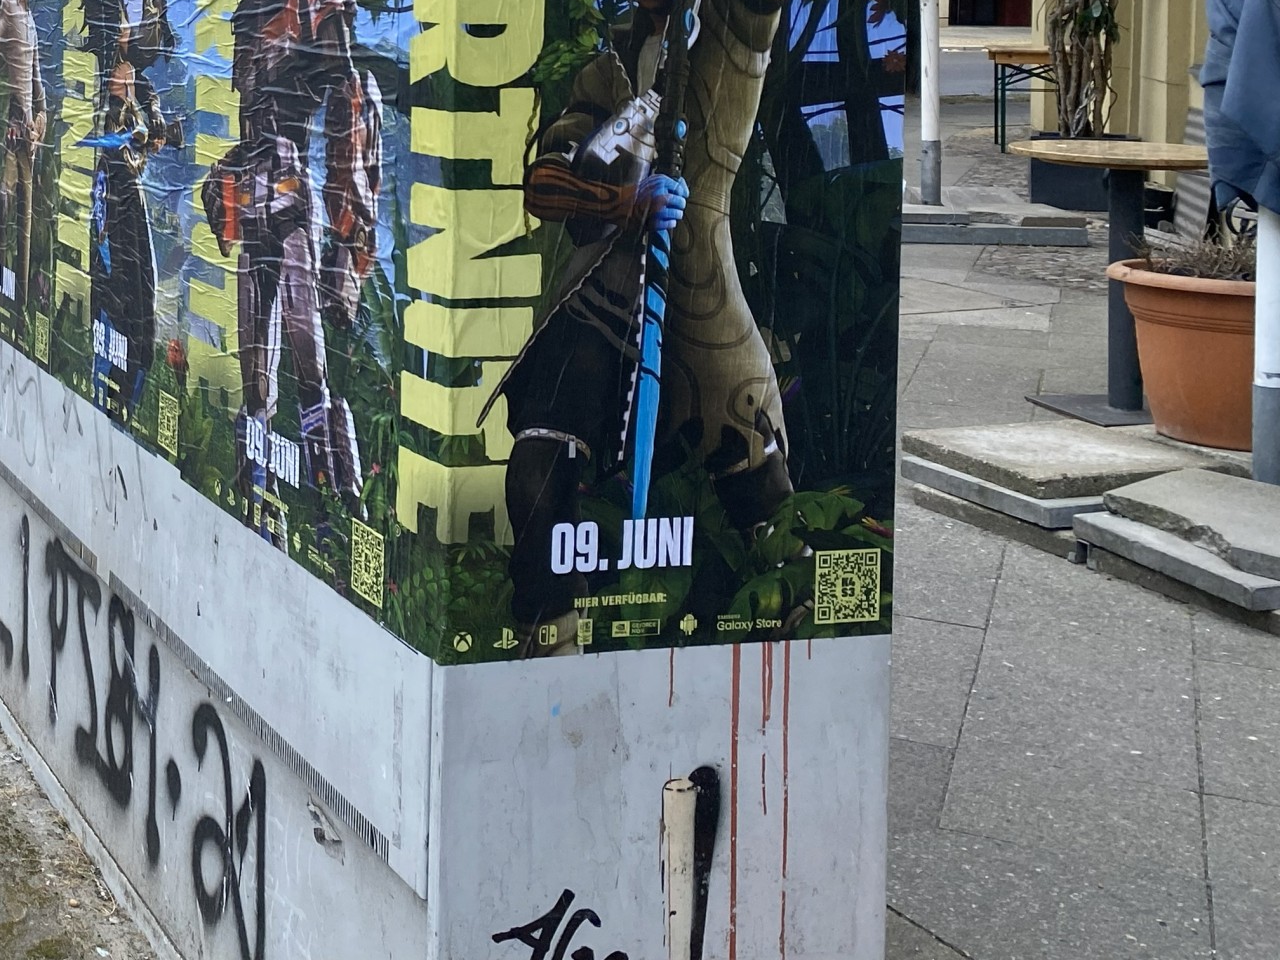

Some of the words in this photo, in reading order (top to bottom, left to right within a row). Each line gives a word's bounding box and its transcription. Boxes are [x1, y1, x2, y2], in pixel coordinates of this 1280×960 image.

[246, 416, 268, 468] 09.
[268, 430, 300, 489] JUNI
[551, 521, 609, 575] 09.
[617, 516, 694, 570] JUNI
[574, 596, 599, 609] HIER
[601, 592, 667, 607] VERFÜGBAR:
[716, 620, 754, 632] Galaxy
[755, 617, 783, 629] Store
